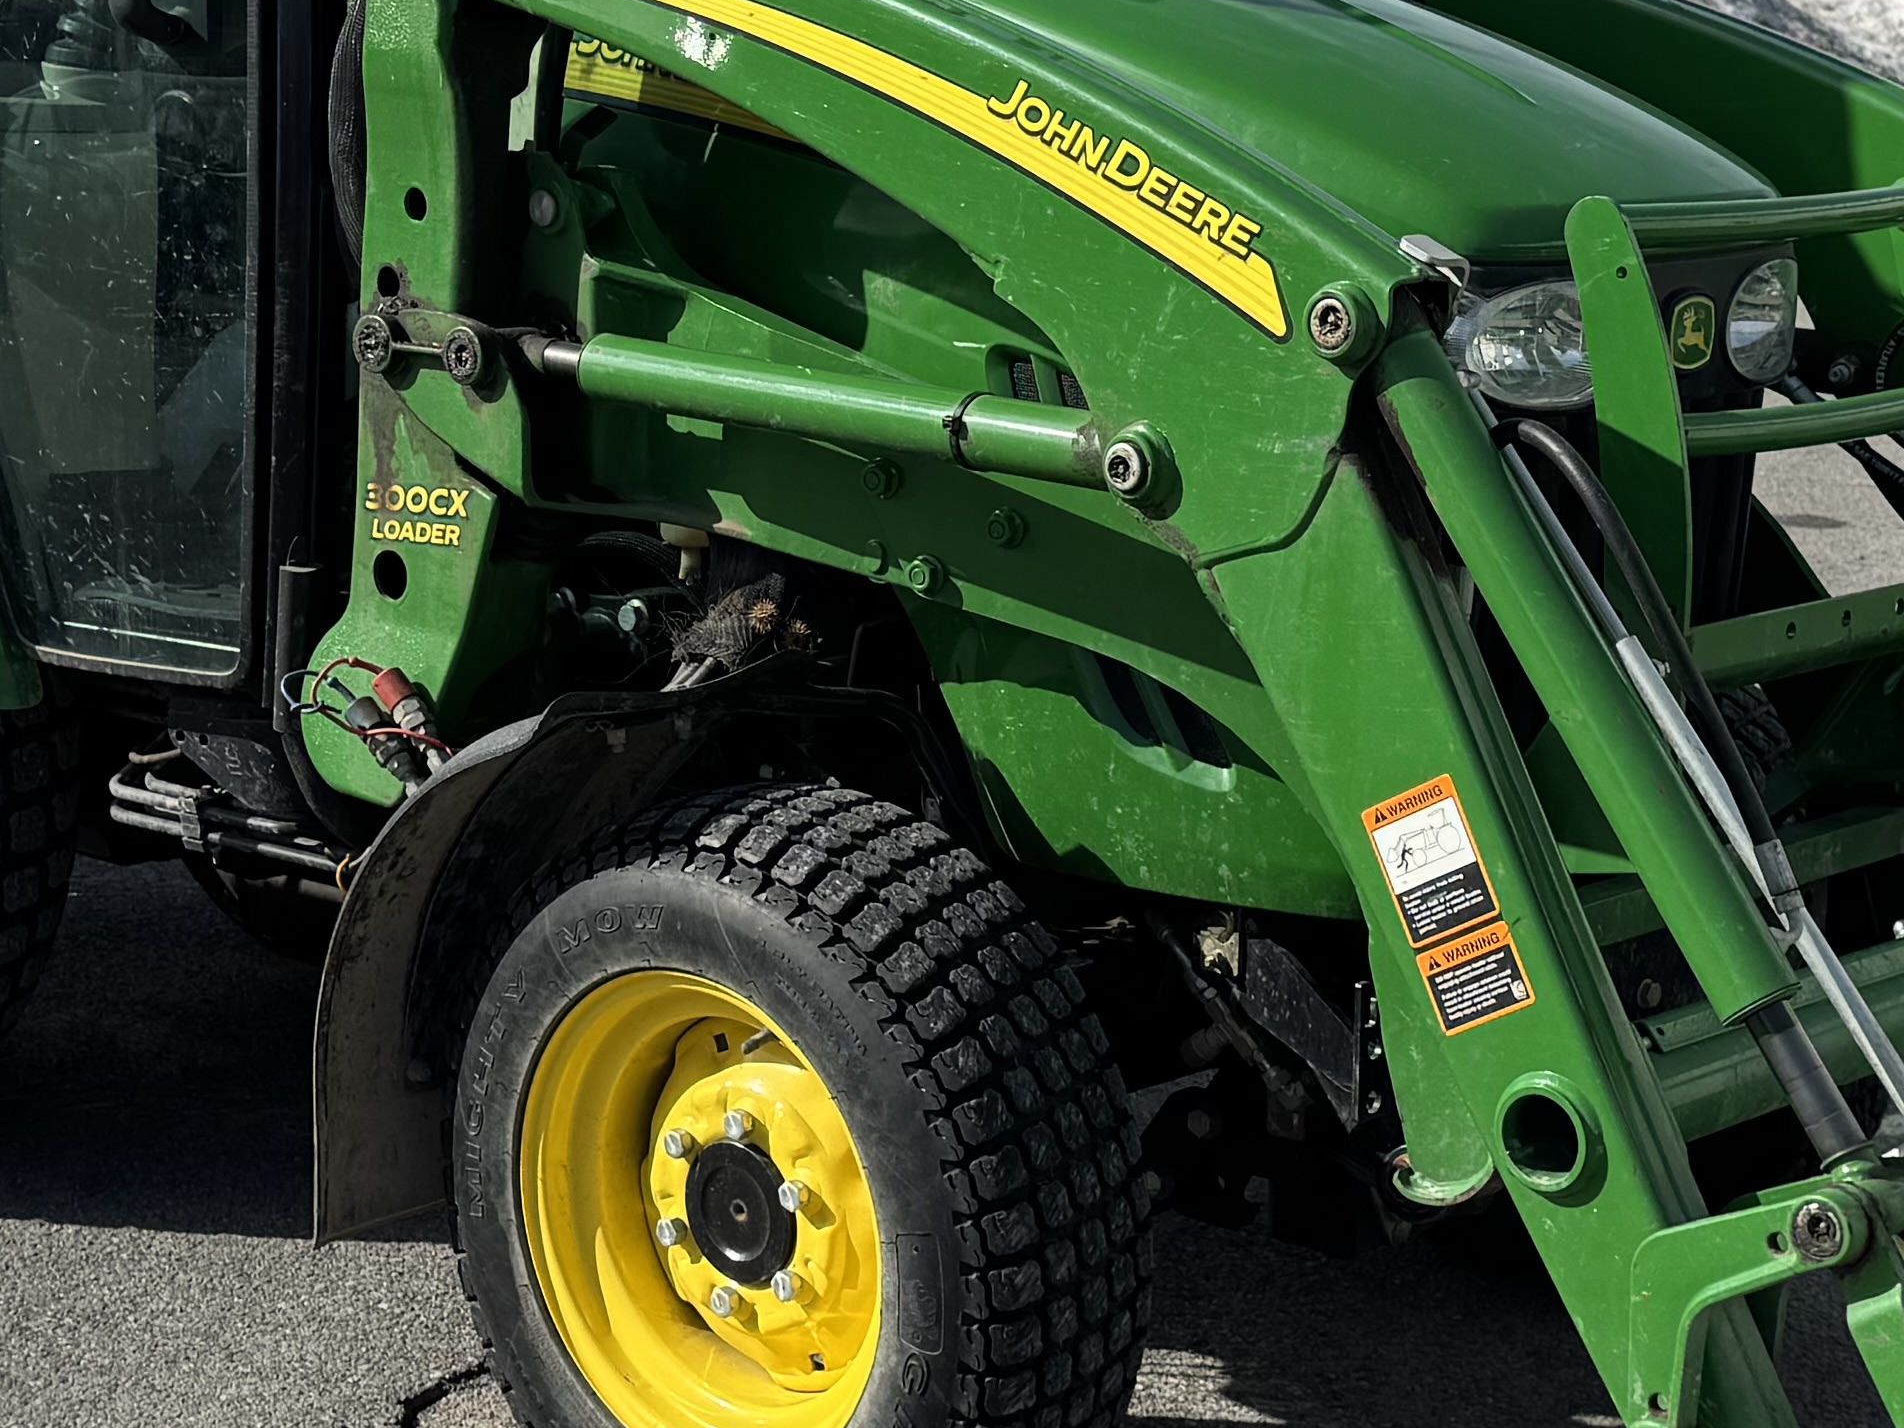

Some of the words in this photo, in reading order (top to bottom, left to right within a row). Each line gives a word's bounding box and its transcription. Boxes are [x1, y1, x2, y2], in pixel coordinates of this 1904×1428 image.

[986, 78, 1112, 172] JOHN
[1100, 137, 1264, 260] DEERE
[365, 482, 470, 518] 300CX
[371, 517, 462, 547] LOADER
[1386, 784, 1444, 818] WARNING
[1442, 931, 1501, 964] WARNING
[466, 965, 532, 1220] MIGHTY
[555, 902, 666, 955] MOW
